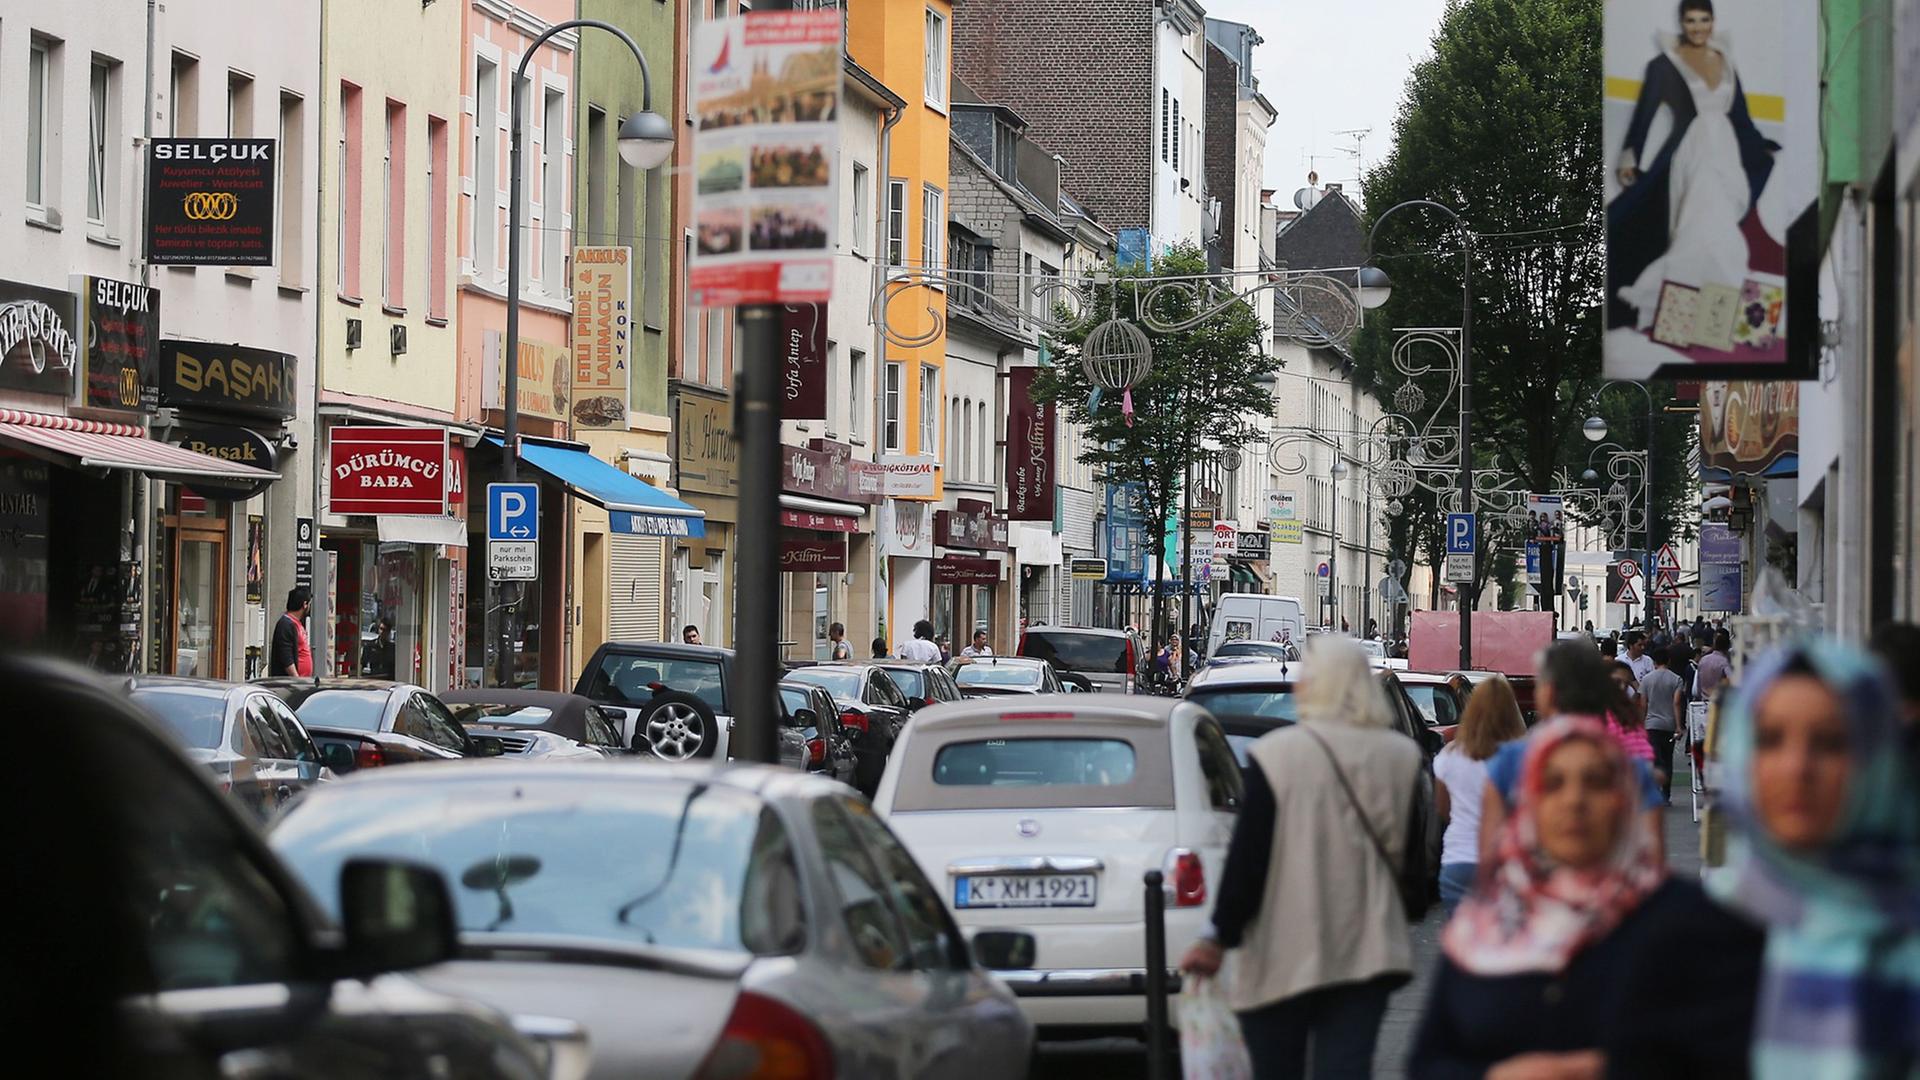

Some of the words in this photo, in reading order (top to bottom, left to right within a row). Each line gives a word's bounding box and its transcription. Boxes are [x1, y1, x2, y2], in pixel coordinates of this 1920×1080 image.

[155, 144, 269, 163] SELÇUK
[163, 167, 213, 177] Kuyumcu
[155, 225, 172, 233] Her
[97, 279, 150, 315] SELÇUK
[597, 274, 611, 385] LAHMACUN
[616, 300, 626, 369] KONYA
[788, 329, 803, 368] Antep
[786, 370, 803, 400] Urfa
[1027, 416, 1047, 482] Kilim
[336, 449, 439, 479] DÜRÜMCÜ
[360, 475, 414, 488] BABA
[500, 492, 526, 533] P
[1212, 530, 1236, 539] PORT
[1453, 518, 1469, 549] P
[494, 554, 532, 562] Parkschein
[783, 548, 826, 564] Kilim
[1622, 565, 1633, 574] 30
[971, 880, 983, 899] K
[1002, 879, 1030, 899] XM
[1035, 878, 1090, 898] 1991
